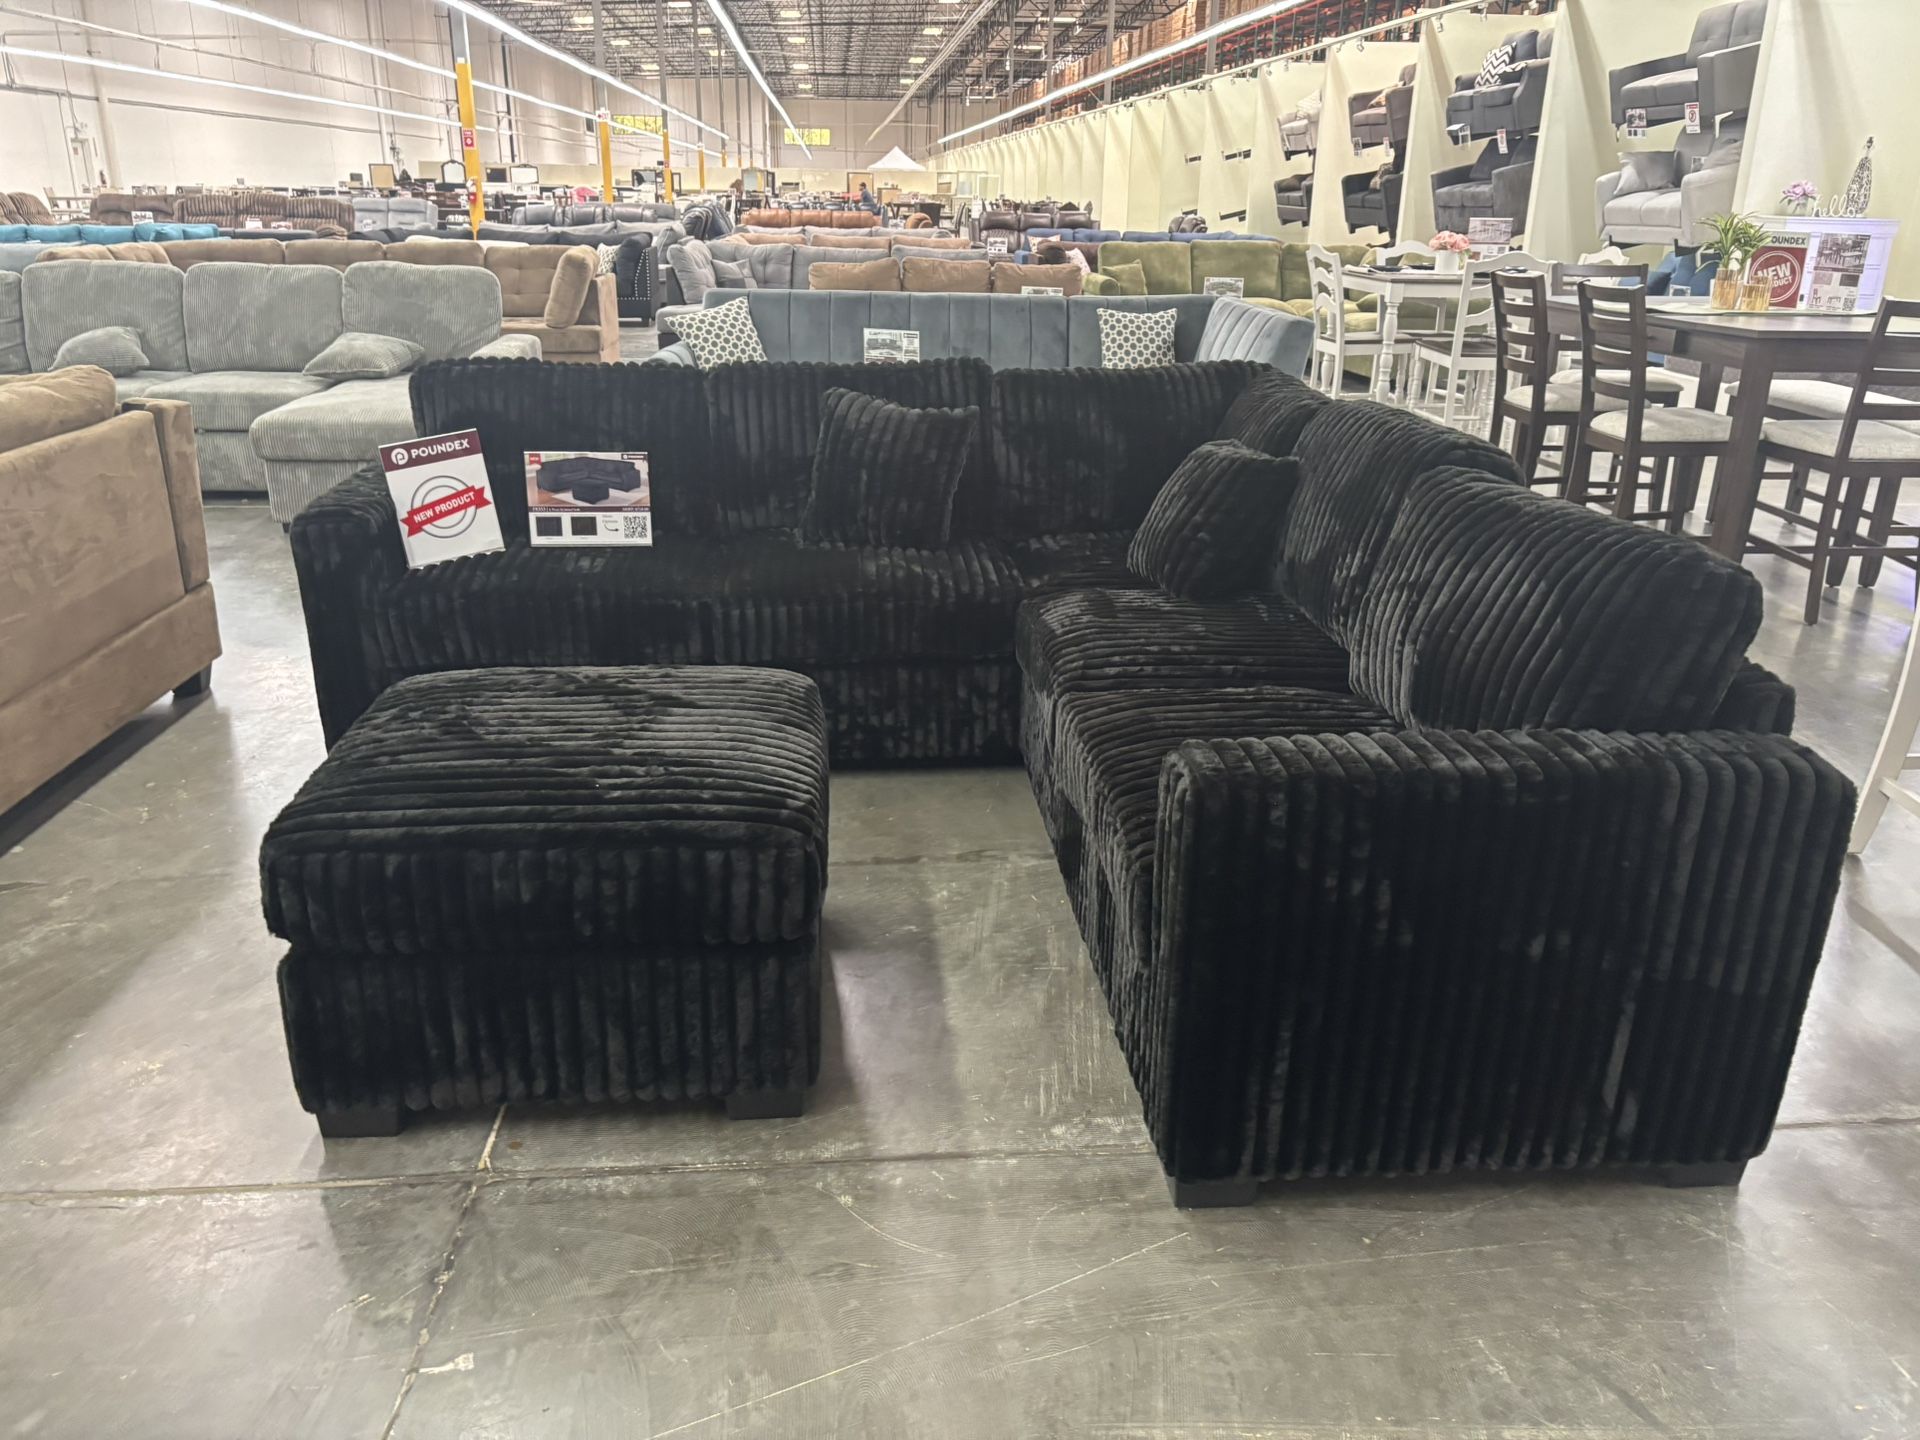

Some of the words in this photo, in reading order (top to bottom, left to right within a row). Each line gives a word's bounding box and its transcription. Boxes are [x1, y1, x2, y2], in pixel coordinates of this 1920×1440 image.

[1811, 194, 1856, 218] hello
[1771, 235, 1807, 246] OUNDEX
[411, 438, 470, 459] POUNDEX
[413, 509, 434, 523] NEW
[434, 491, 476, 514] PRODUCT
